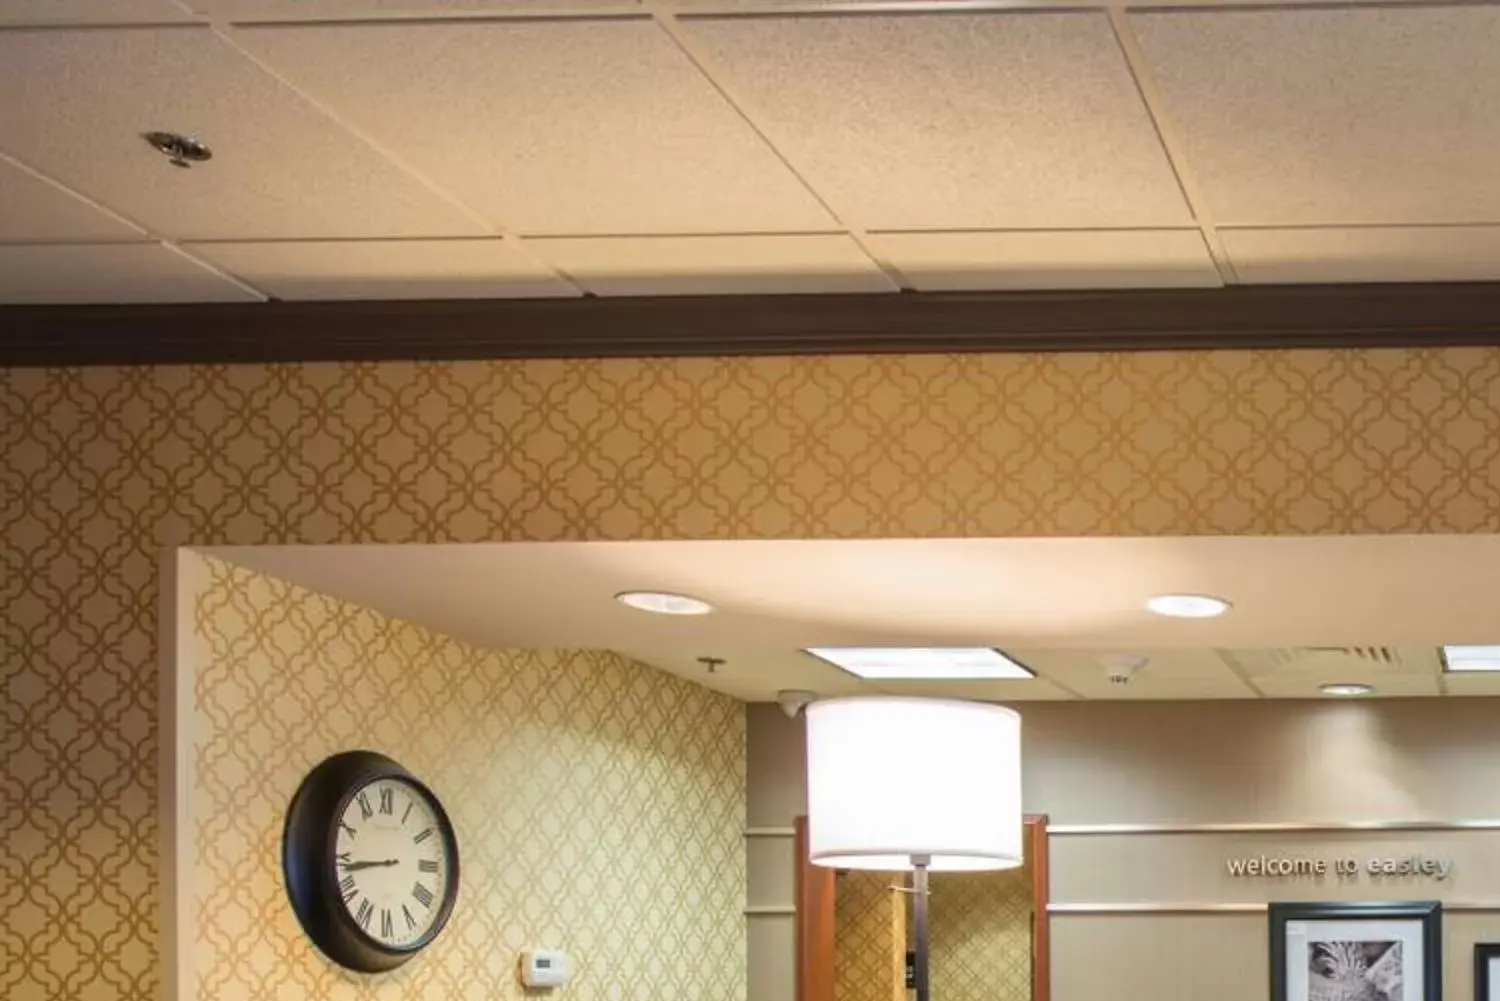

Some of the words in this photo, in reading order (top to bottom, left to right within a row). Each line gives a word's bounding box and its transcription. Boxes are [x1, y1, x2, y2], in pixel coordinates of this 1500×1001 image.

[1226, 855, 1327, 876] welcome
[1334, 856, 1359, 877] to
[1366, 854, 1452, 881] easley
